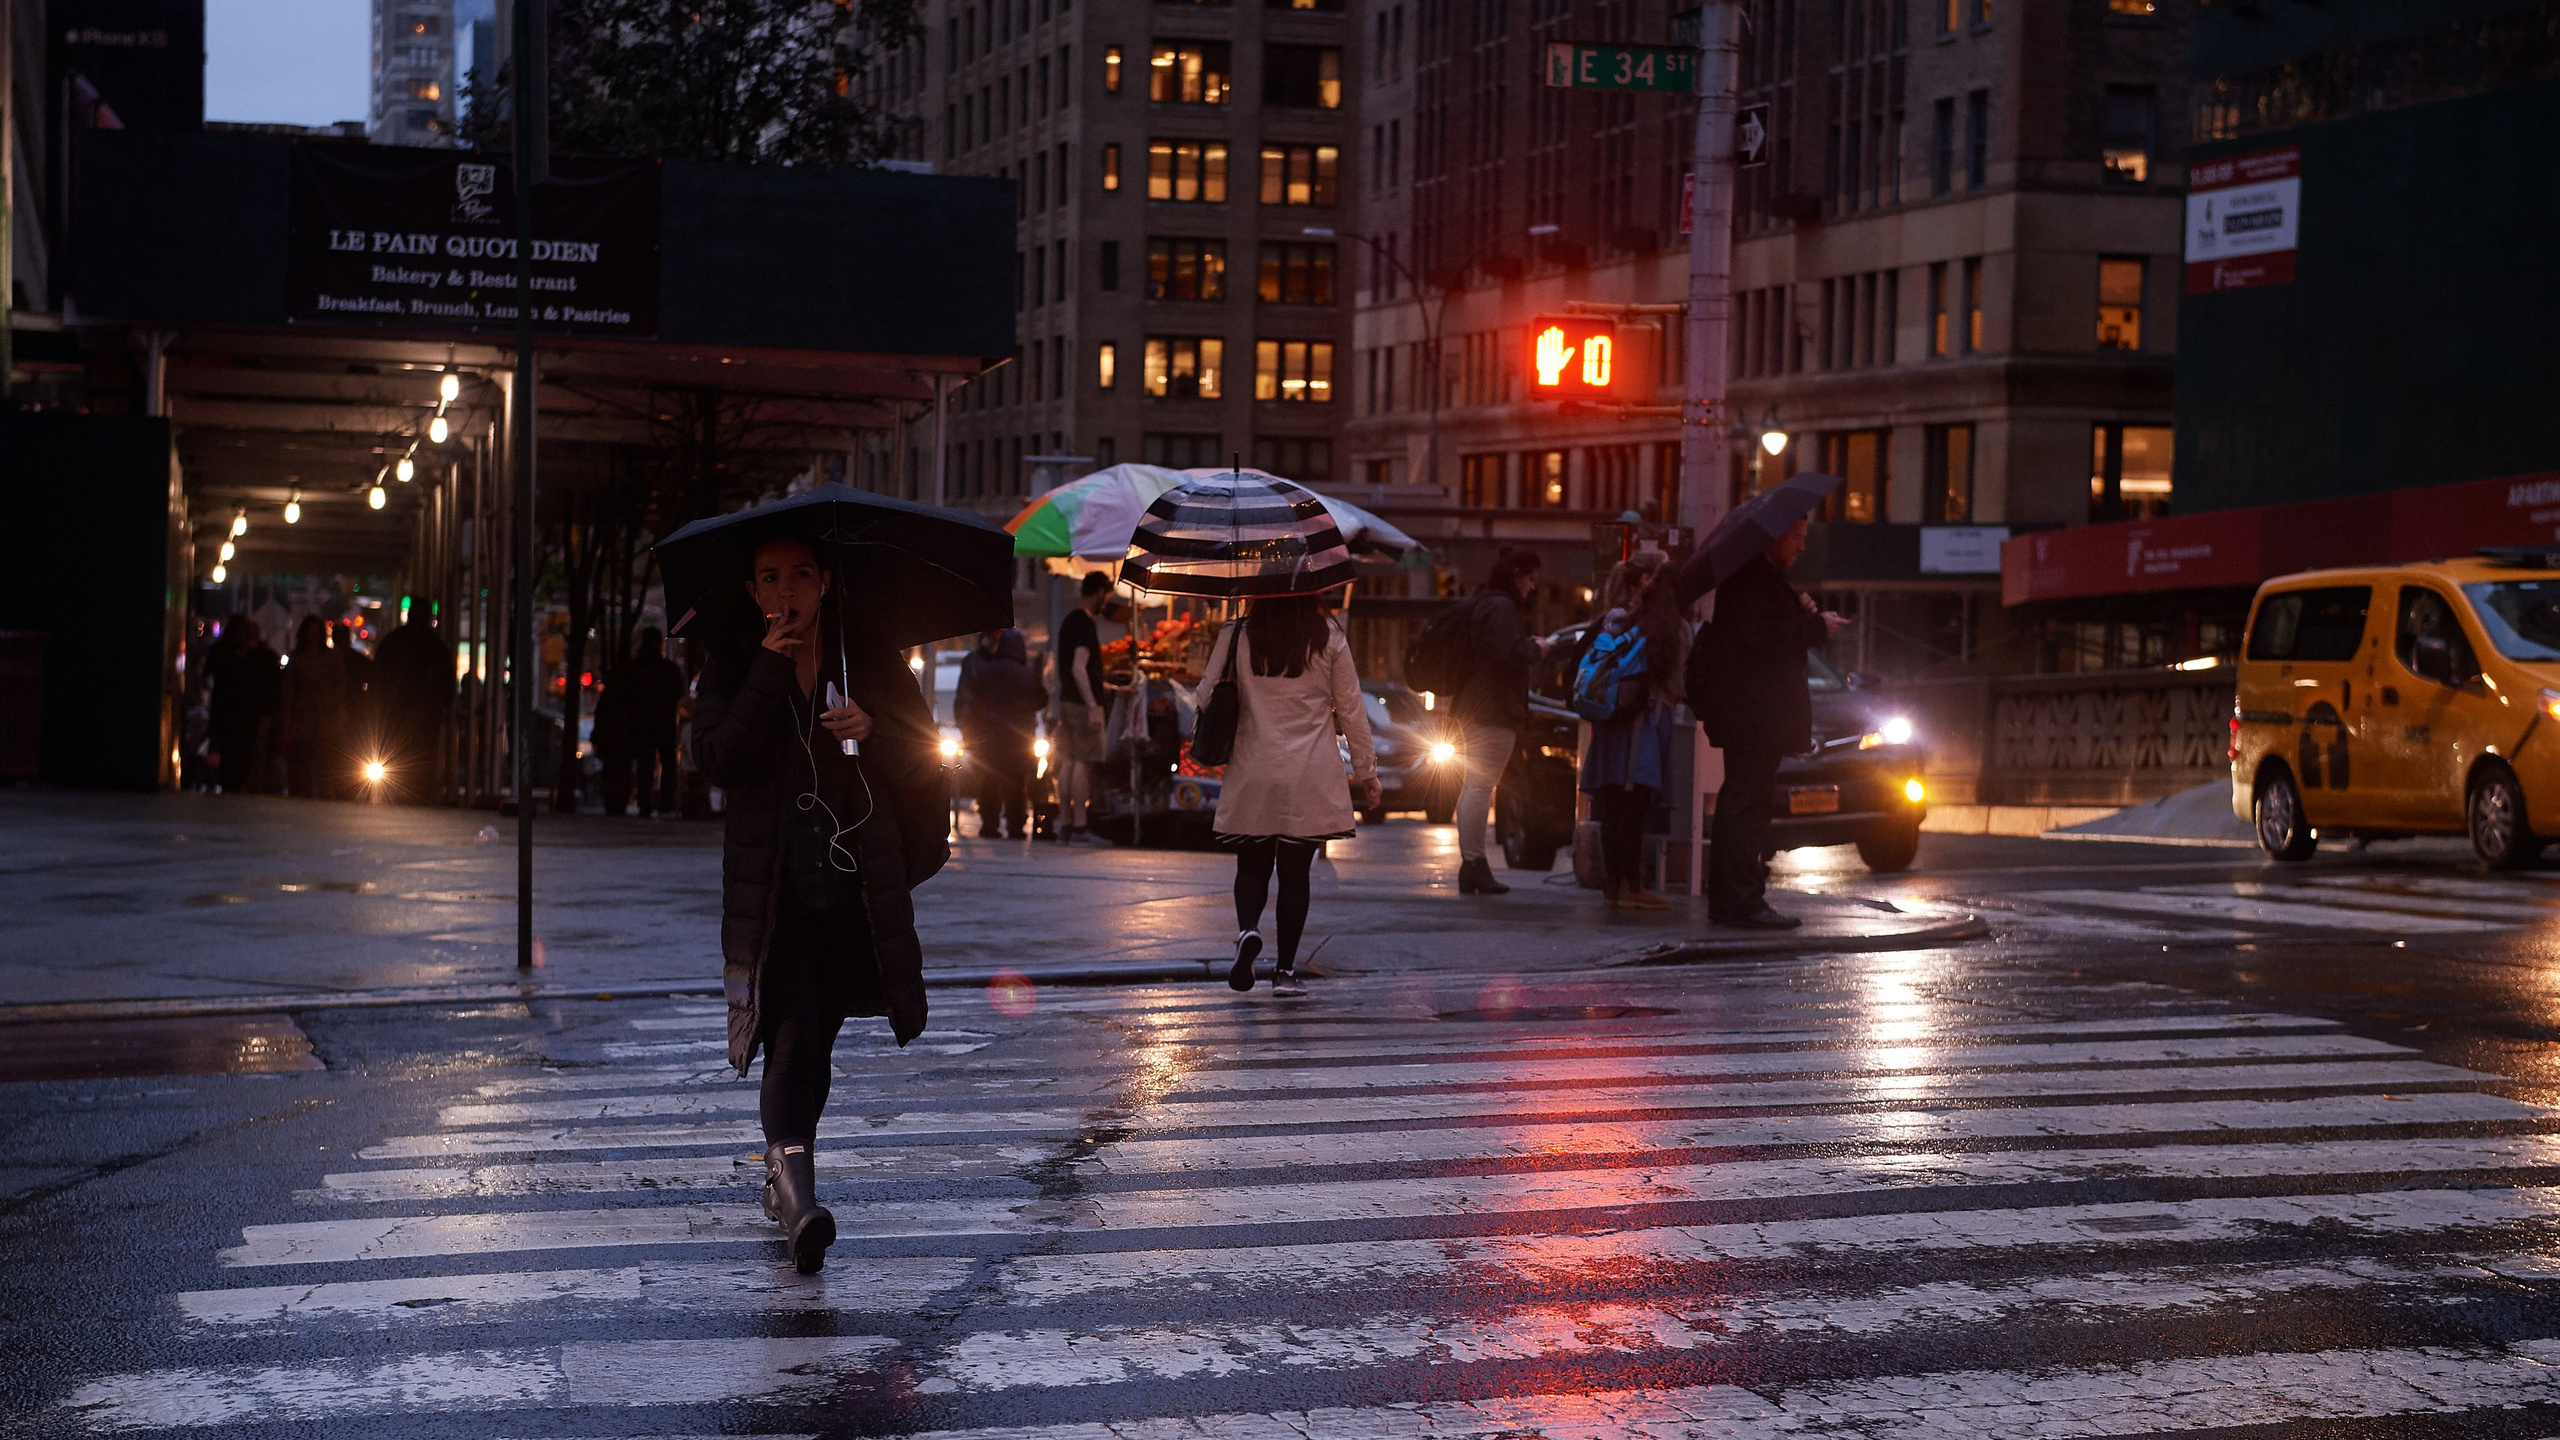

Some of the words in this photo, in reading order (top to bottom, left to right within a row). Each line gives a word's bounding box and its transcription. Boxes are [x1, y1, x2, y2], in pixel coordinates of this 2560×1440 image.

[1579, 50, 1599, 84] E
[1613, 52, 1656, 87] 34
[1665, 54, 1688, 72] ST
[328, 229, 366, 252] LE
[371, 231, 439, 256] PAIN
[445, 235, 601, 263] QUOTDIEN
[370, 264, 443, 289] Bakery
[446, 268, 465, 287] &
[317, 293, 407, 316] Breakfast,
[410, 298, 481, 319] Brunch,
[484, 302, 540, 321] Lunh
[543, 304, 560, 321] &
[562, 306, 632, 325] Pastries
[1582, 335, 1612, 387] 10
